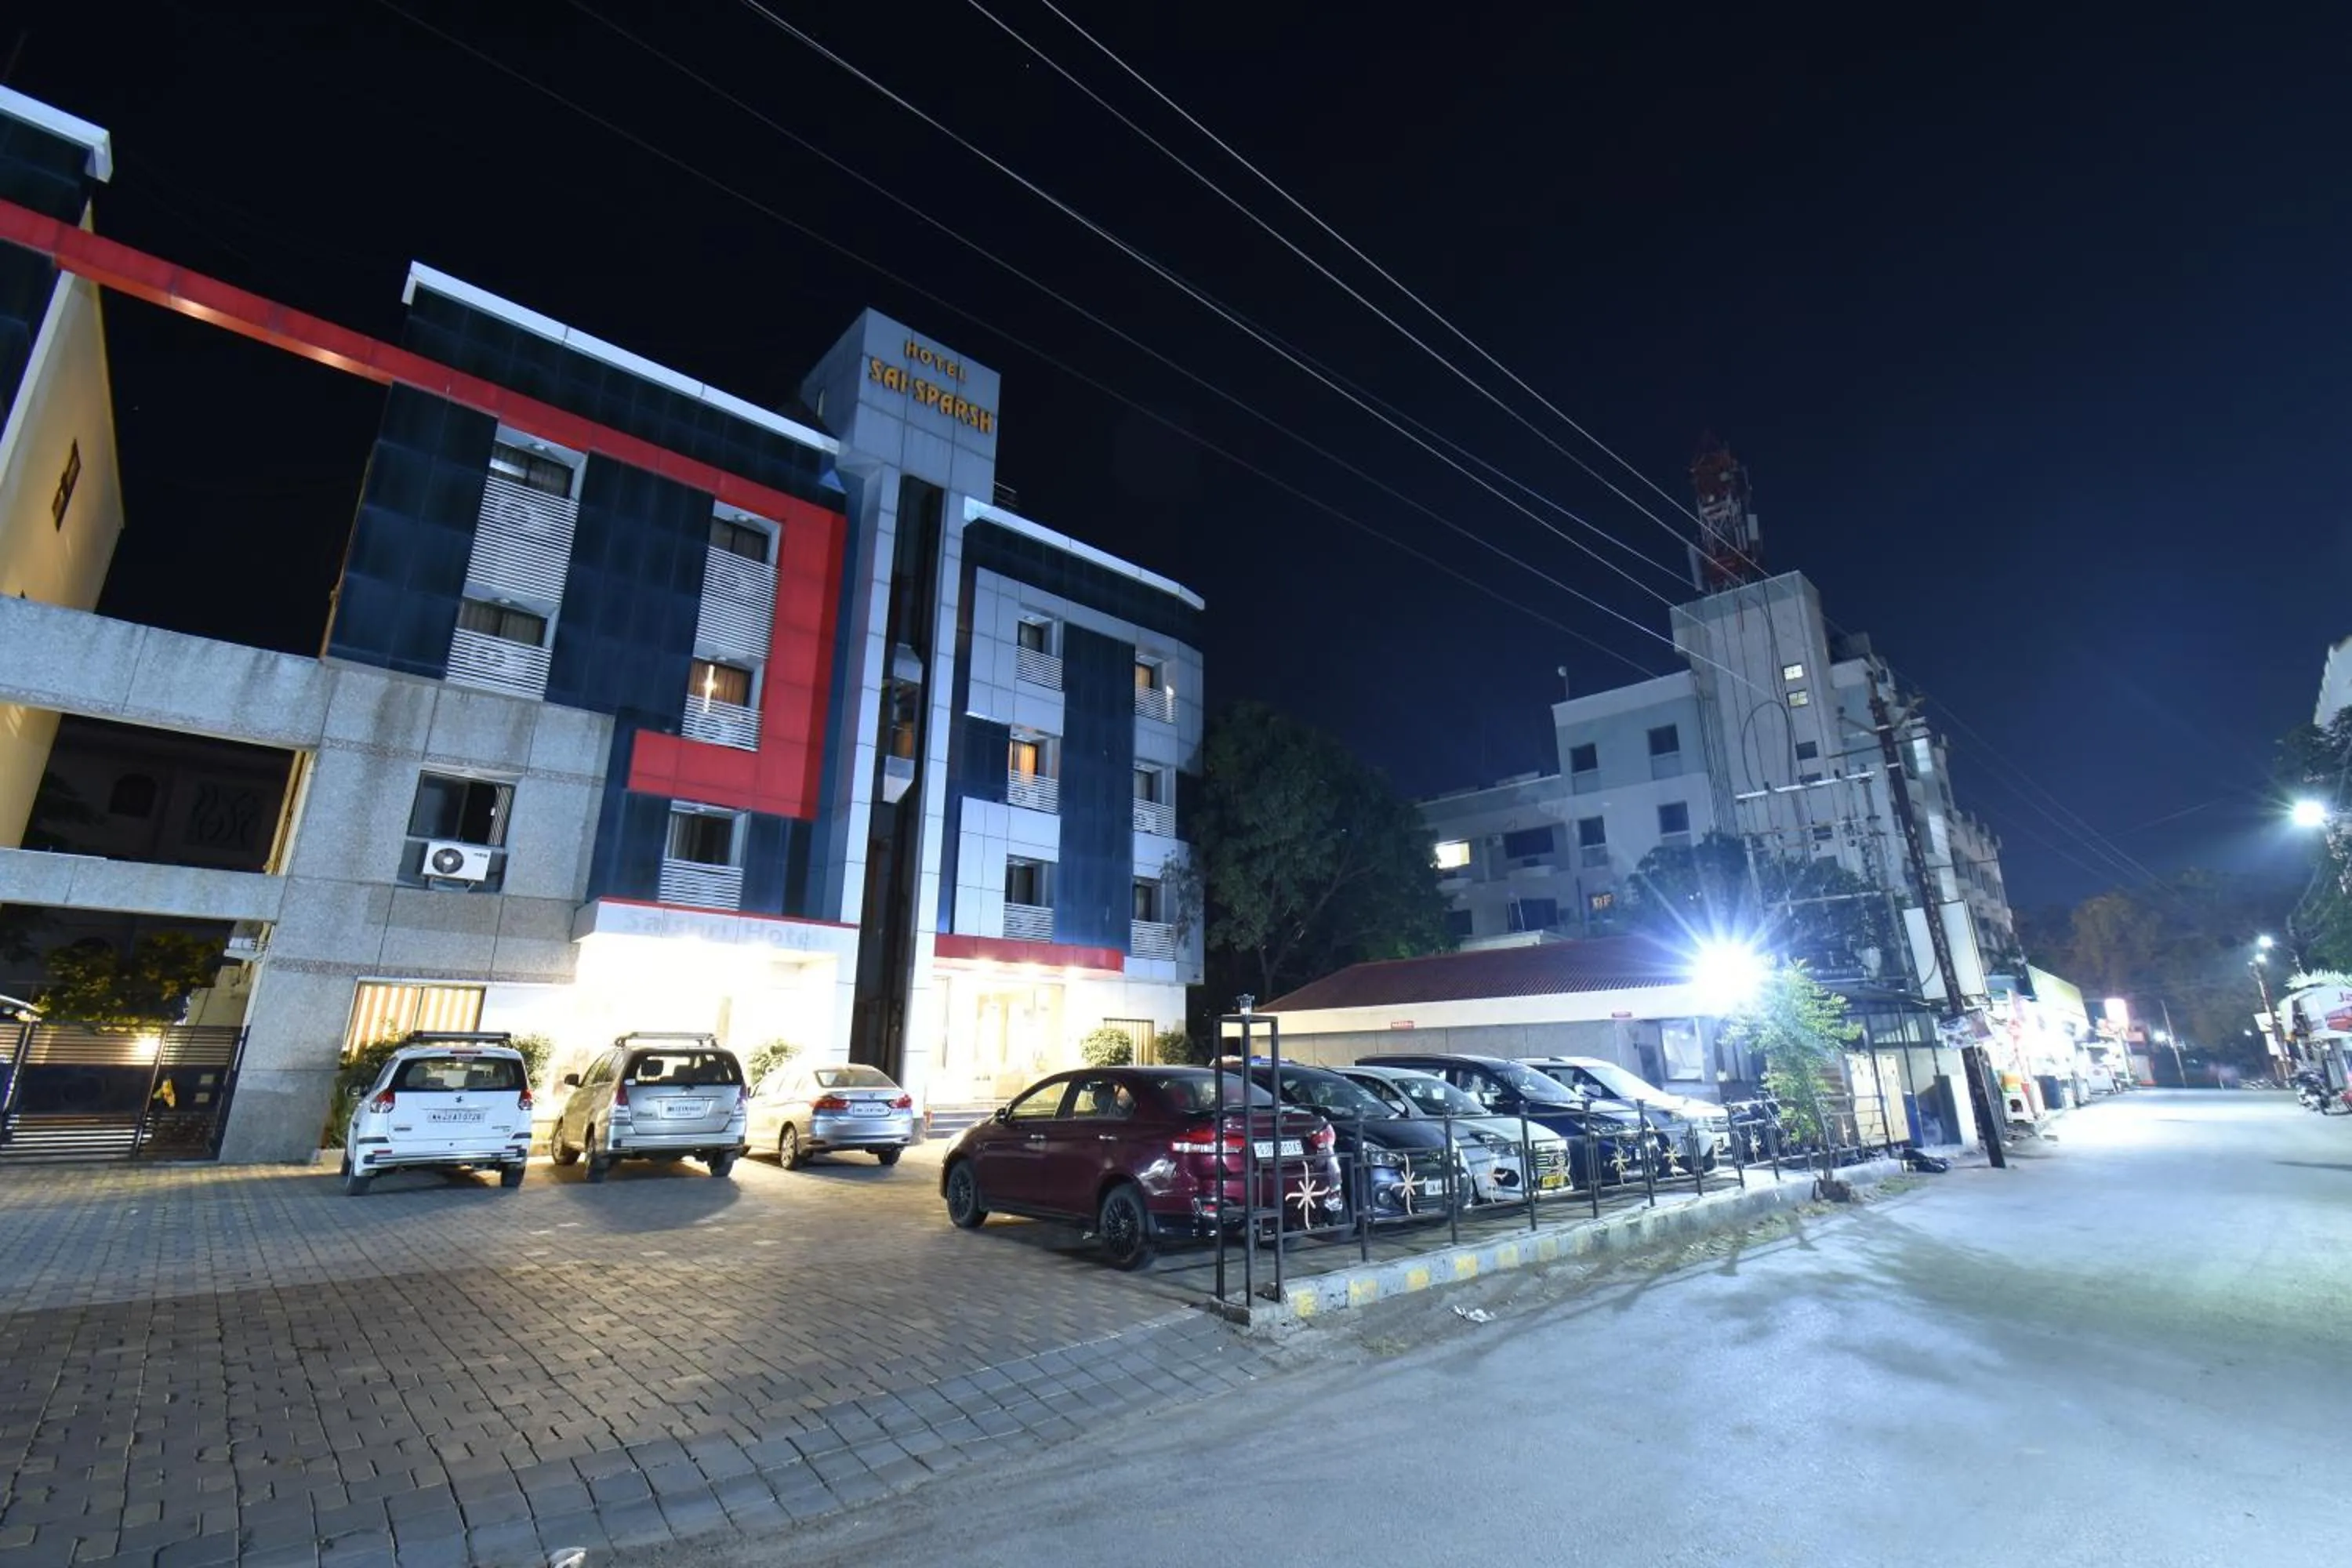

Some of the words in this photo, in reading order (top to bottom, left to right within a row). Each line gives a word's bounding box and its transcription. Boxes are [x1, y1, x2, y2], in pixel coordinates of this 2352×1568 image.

[905, 339, 966, 382] HOTEL
[869, 357, 908, 393] SAI
[913, 378, 993, 434] SPARSH
